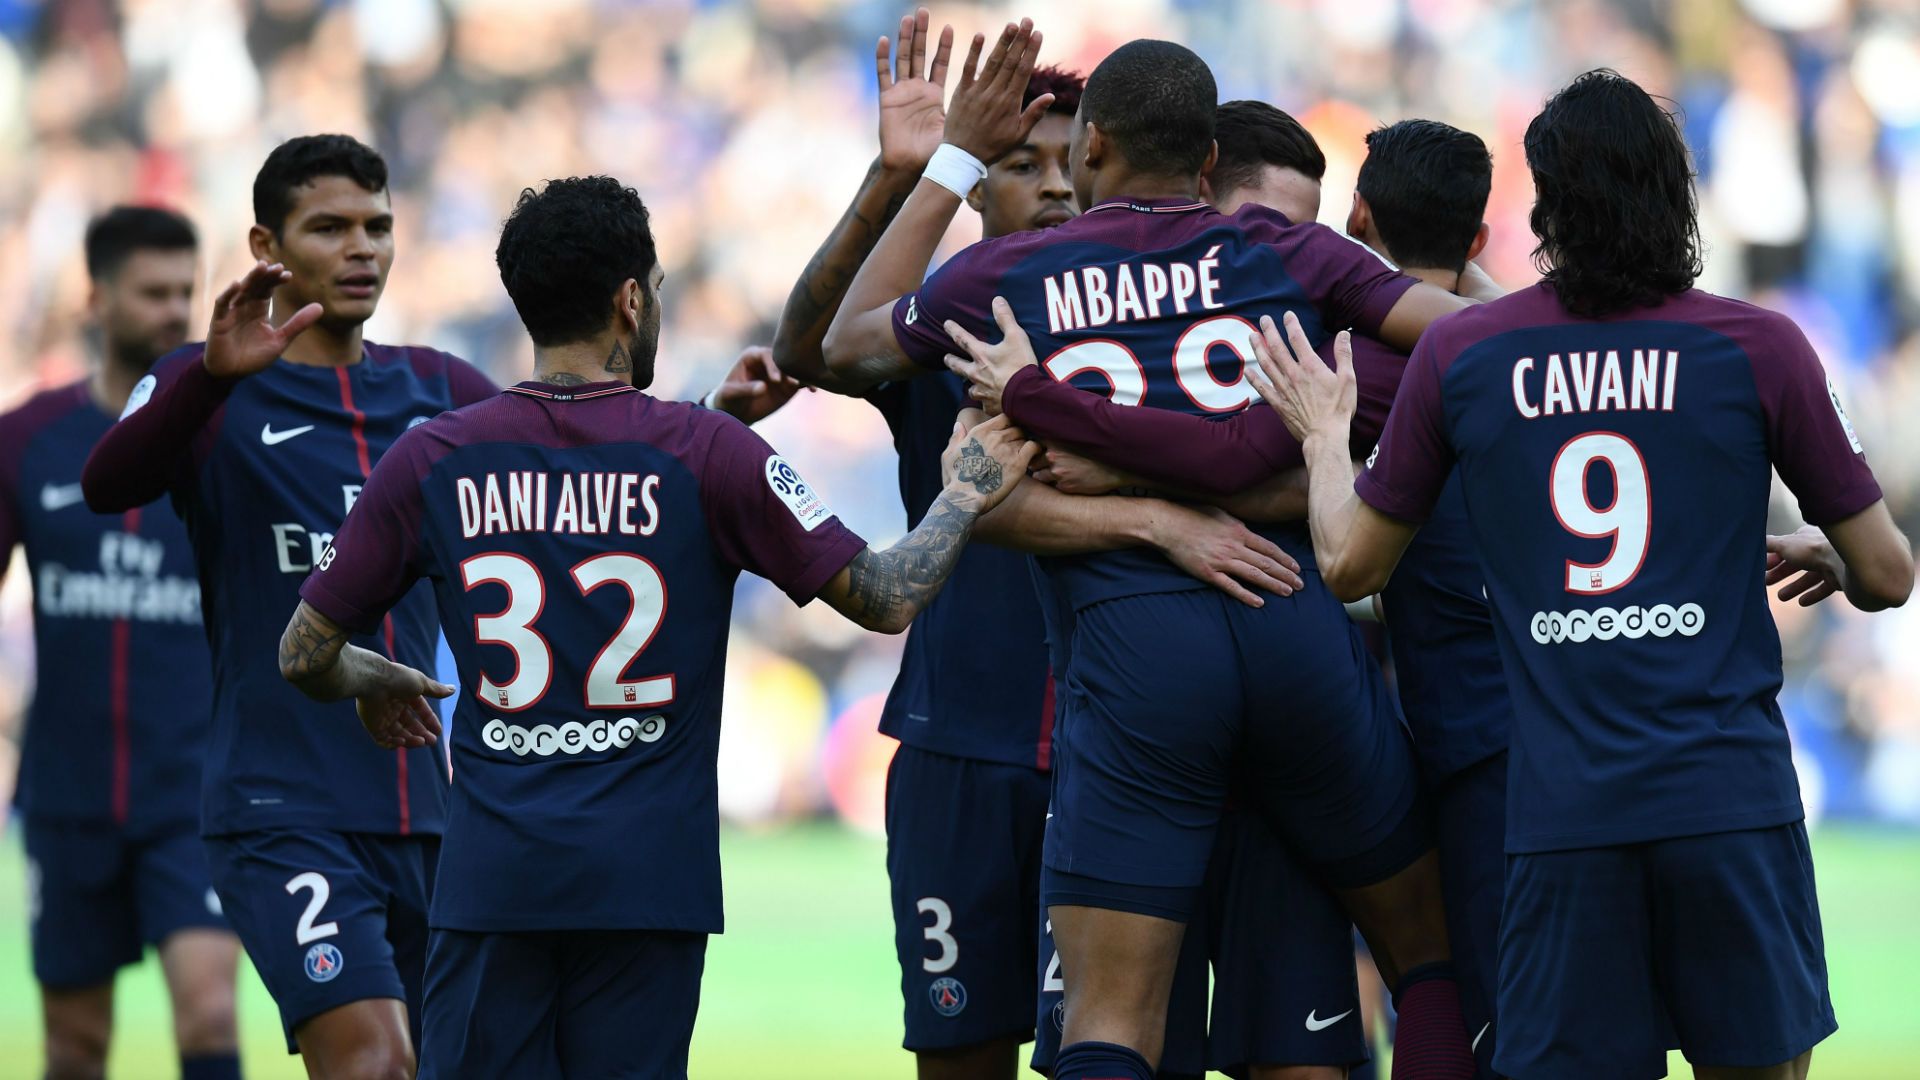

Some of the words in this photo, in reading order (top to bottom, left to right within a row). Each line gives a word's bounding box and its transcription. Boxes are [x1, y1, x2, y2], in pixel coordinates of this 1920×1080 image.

[1131, 204, 1151, 212] PARIS
[1043, 244, 1226, 334] MBAPPÉ
[1511, 349, 1679, 420] CAVANI
[456, 470, 548, 539] DANI
[551, 472, 660, 536] ALVES
[1549, 430, 1652, 595] 9
[39, 562, 203, 624] Emirate
[1530, 602, 1705, 645] ooredoo
[459, 551, 676, 713] 32
[482, 715, 666, 757] ooredoo
[285, 871, 339, 946] 2
[916, 896, 959, 973] 3
